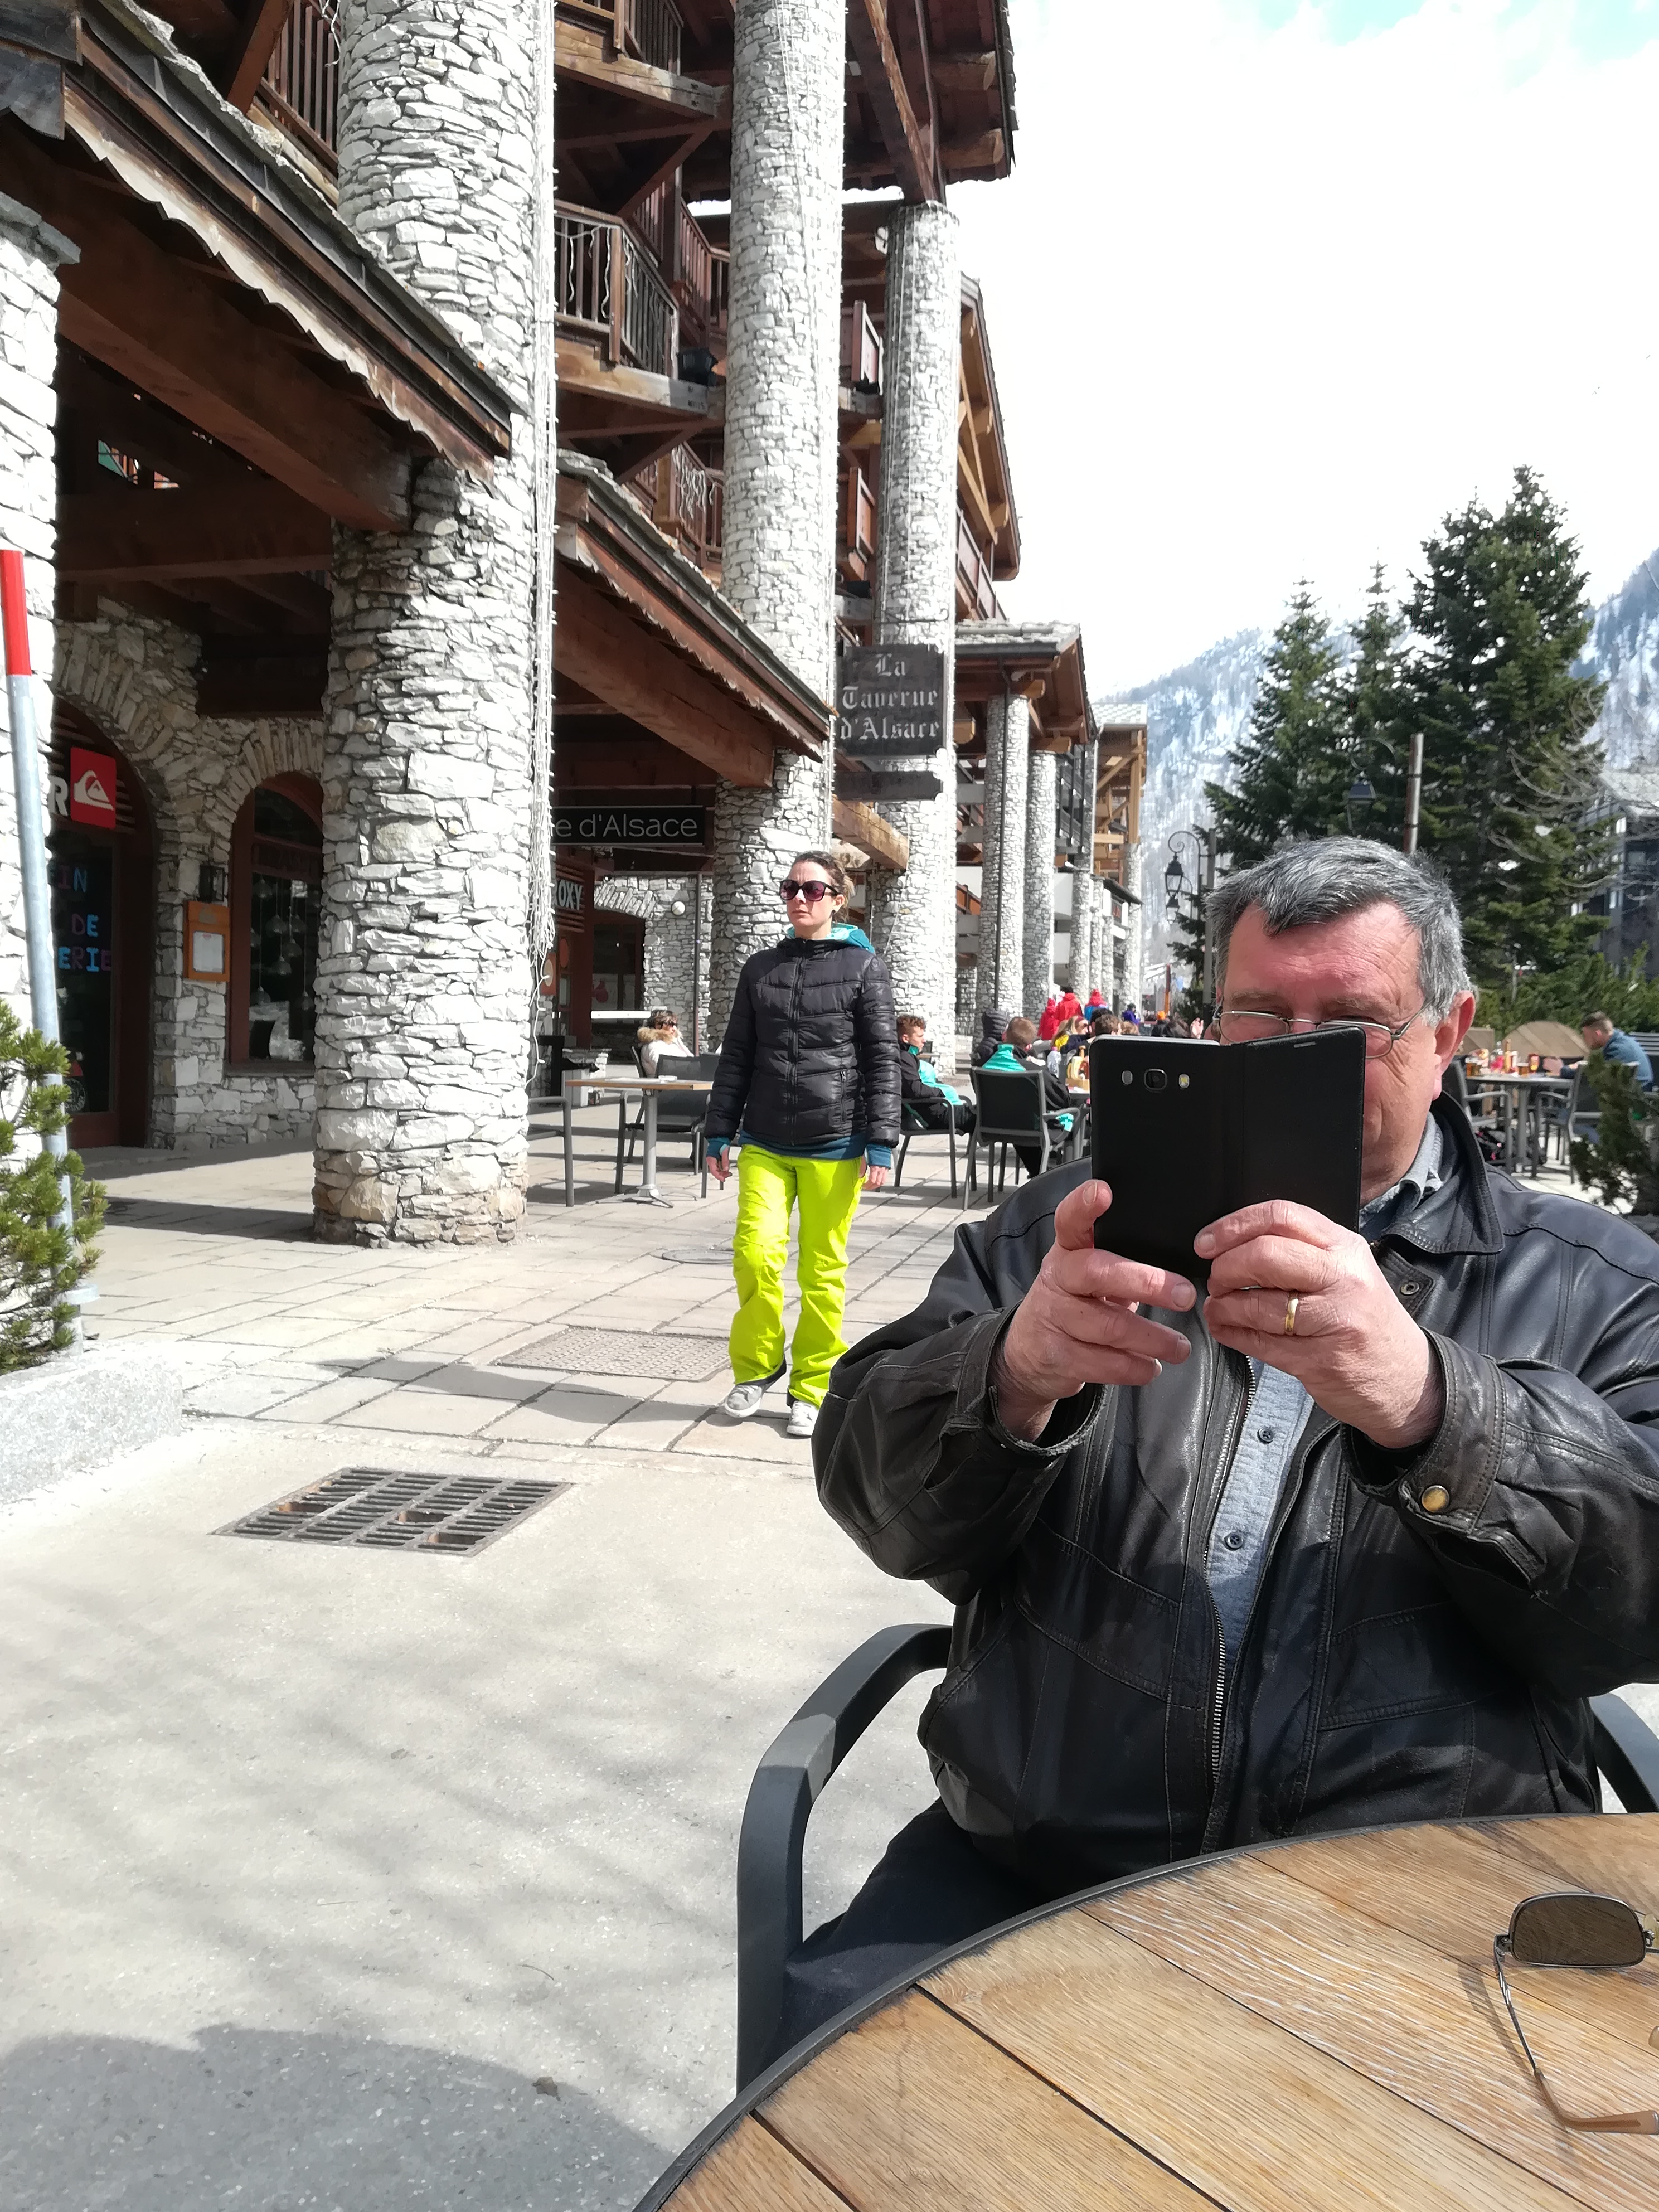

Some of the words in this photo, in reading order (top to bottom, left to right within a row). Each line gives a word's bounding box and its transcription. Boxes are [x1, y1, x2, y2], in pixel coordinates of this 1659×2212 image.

[875, 653, 906, 676] La
[842, 686, 938, 710] Taverne
[840, 717, 940, 740] d'Alsace
[579, 813, 698, 837] d'Alsace
[55, 864, 88, 893] IN
[71, 913, 100, 937] DE
